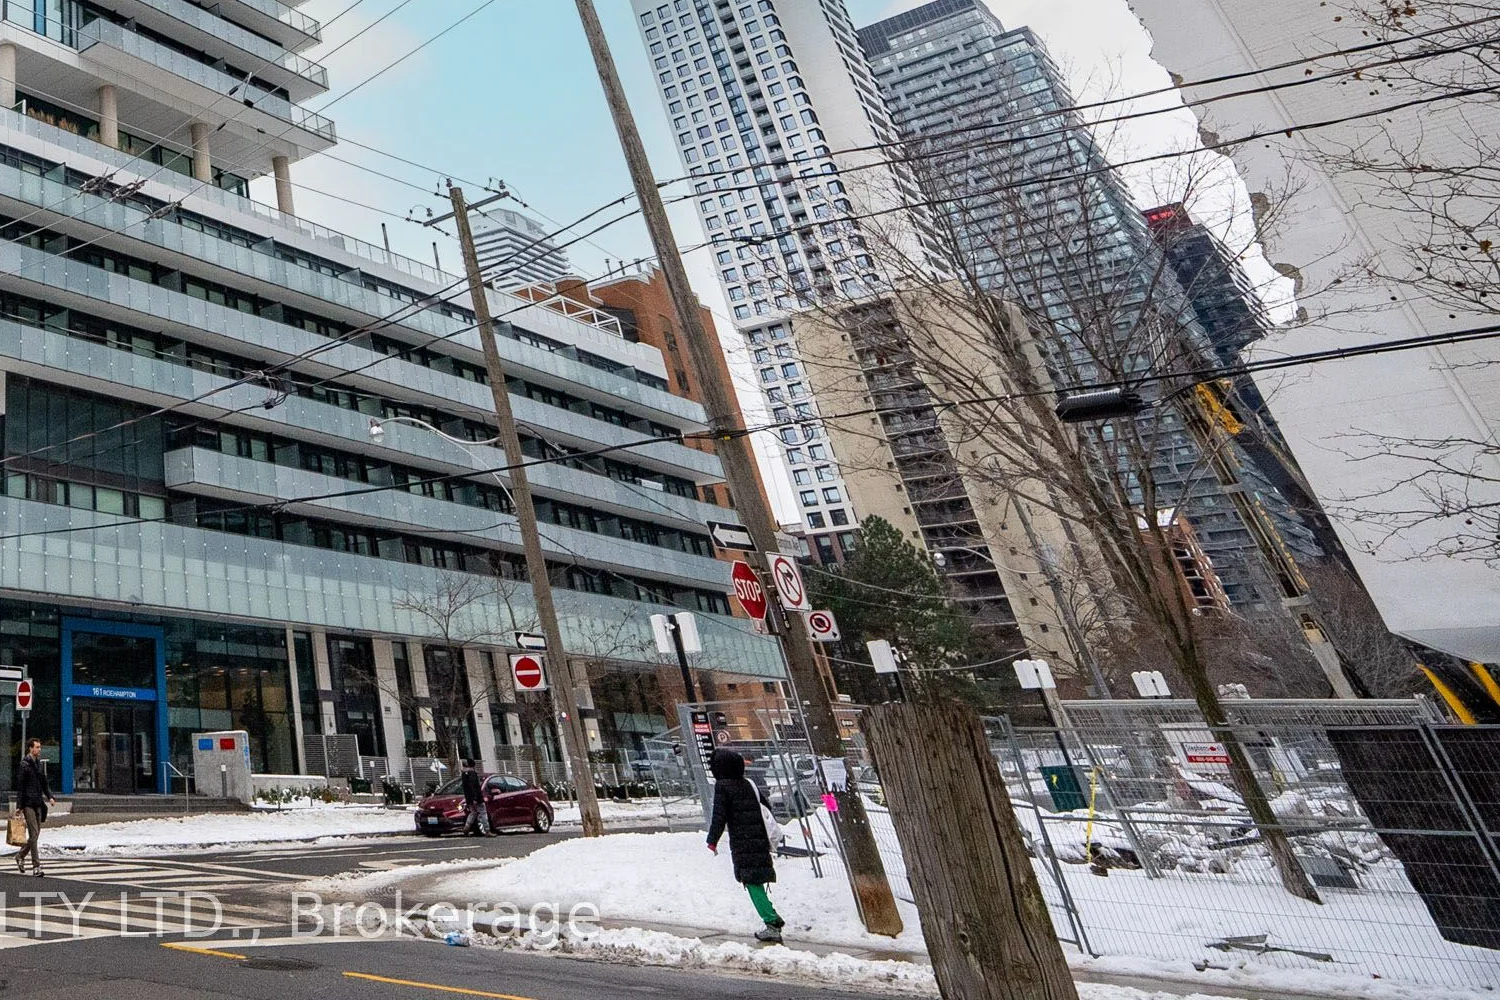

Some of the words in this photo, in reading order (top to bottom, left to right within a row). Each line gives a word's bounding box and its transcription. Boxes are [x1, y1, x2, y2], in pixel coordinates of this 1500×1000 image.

[734, 578, 762, 602] STOP
[92, 687, 103, 697] 161
[103, 689, 137, 698] ROEHAMPTON
